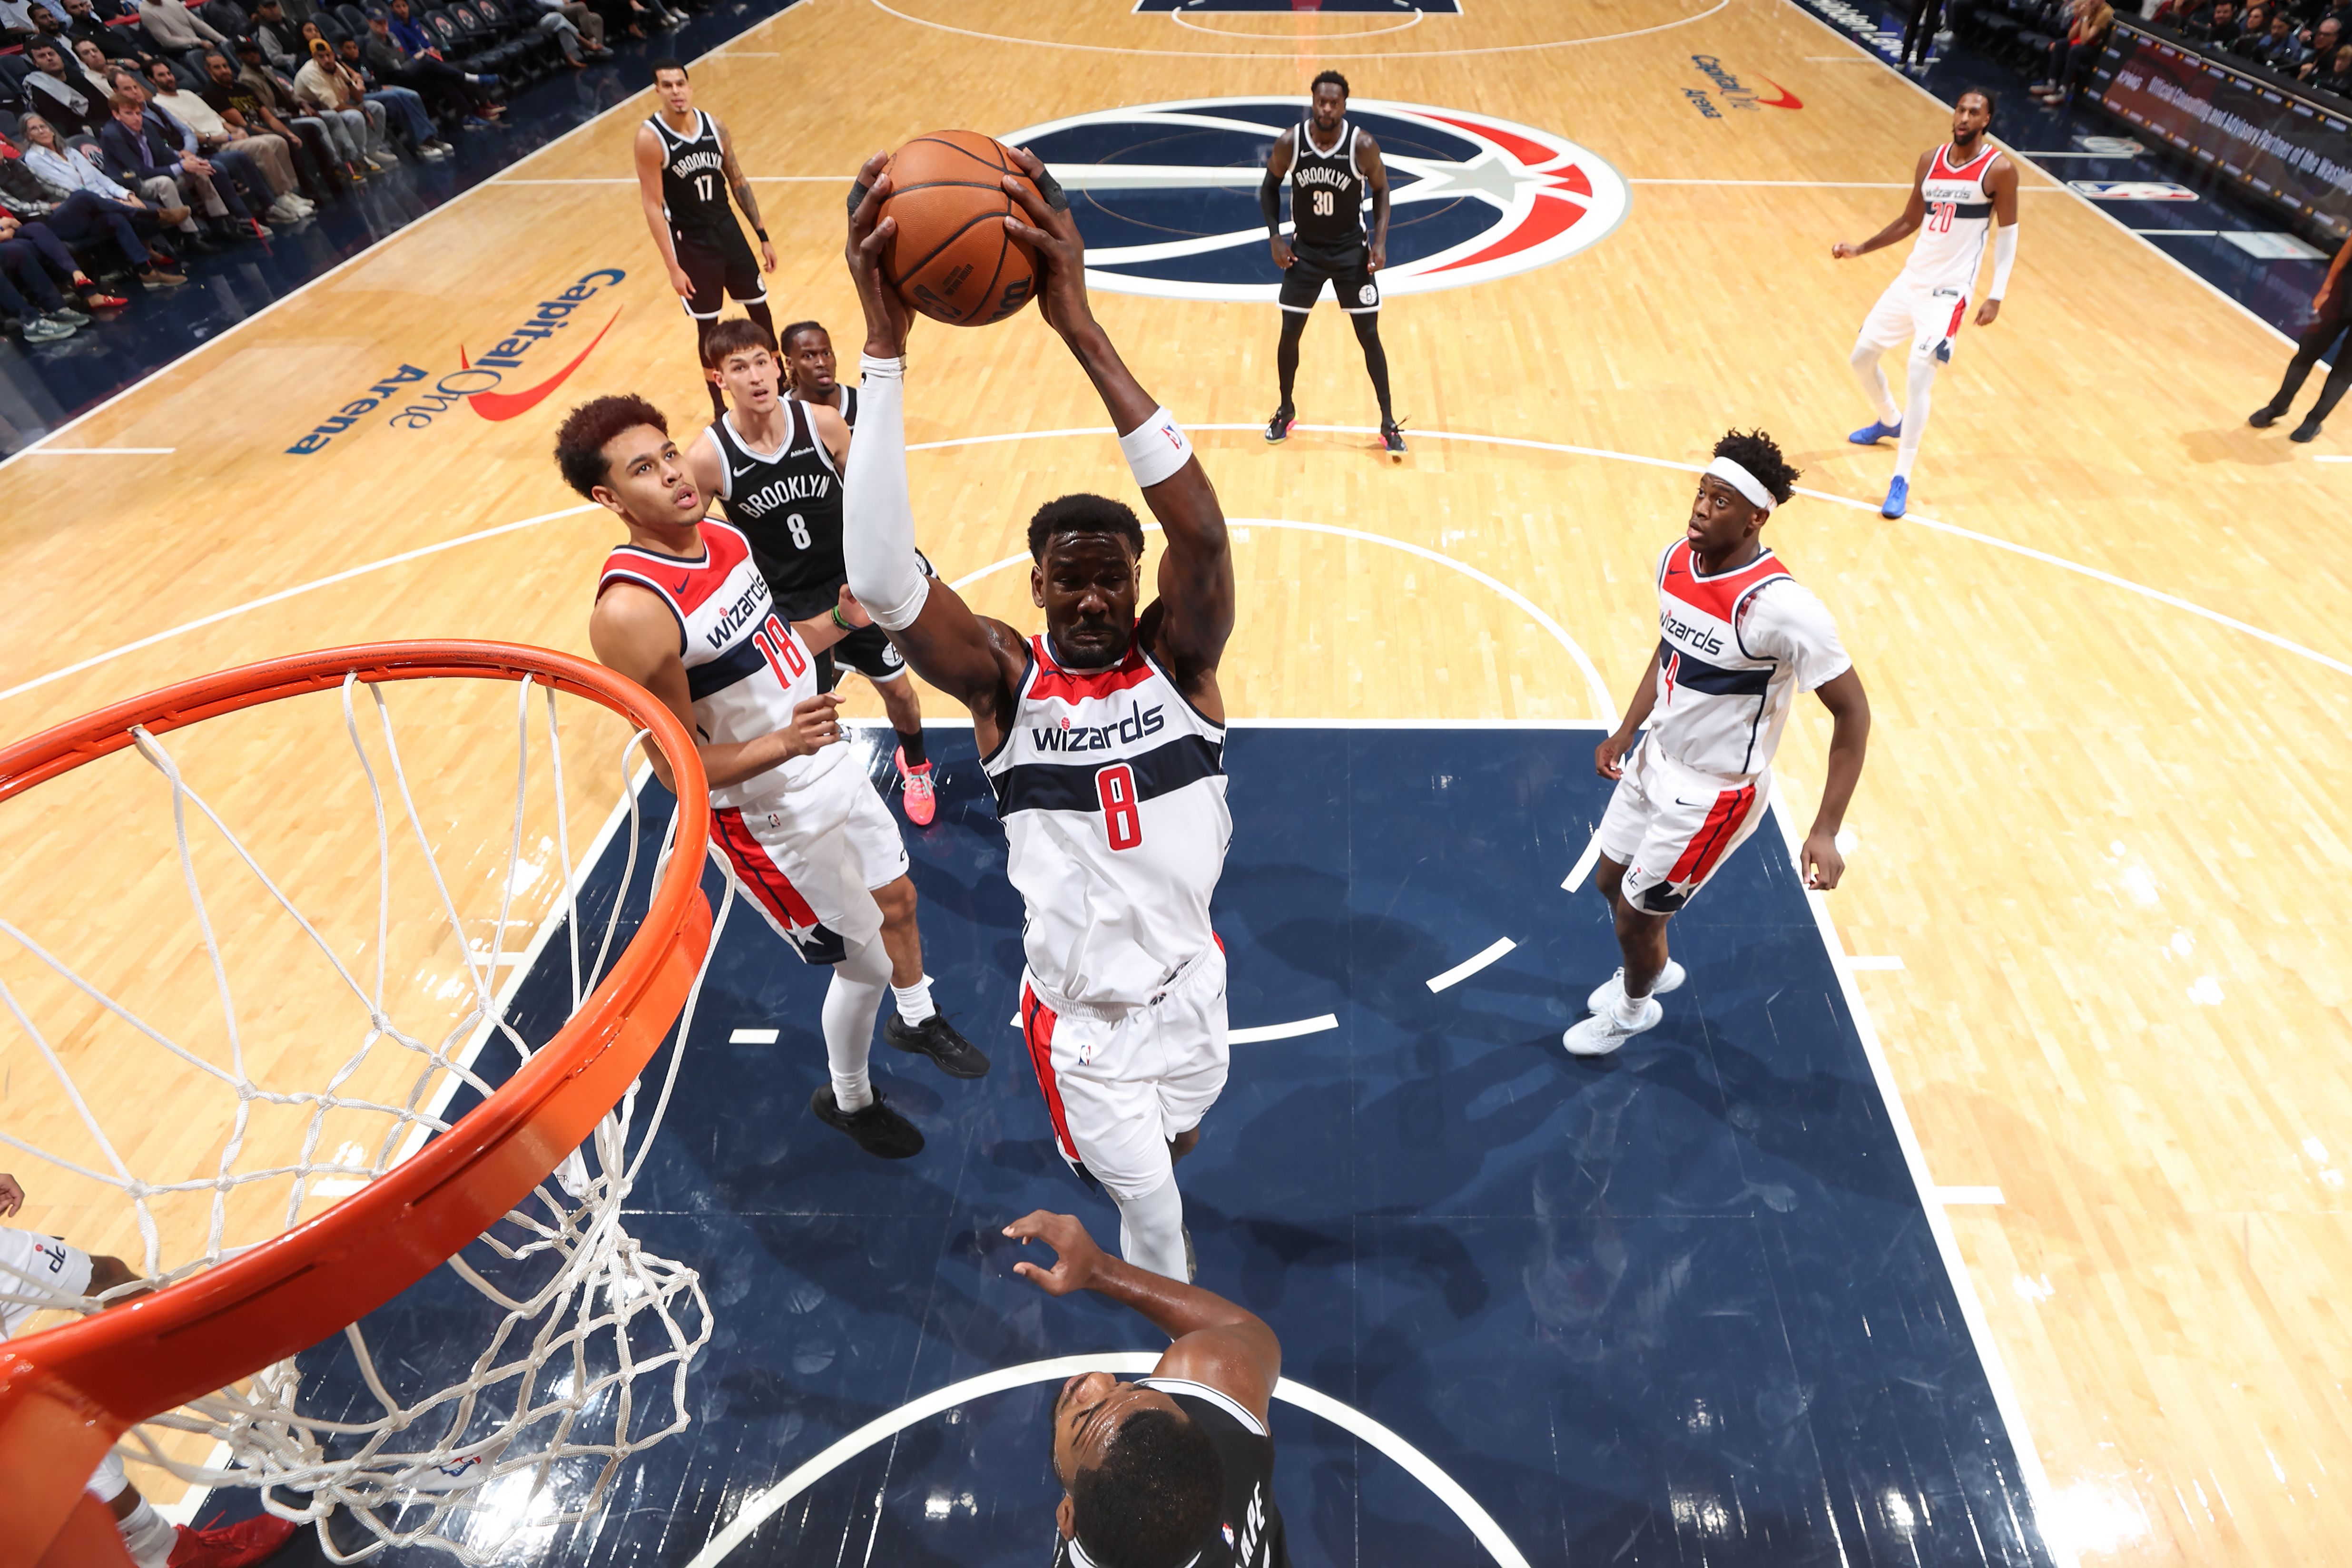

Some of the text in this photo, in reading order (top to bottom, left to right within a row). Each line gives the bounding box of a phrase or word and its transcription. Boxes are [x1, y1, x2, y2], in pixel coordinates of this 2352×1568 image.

[671, 151, 724, 179] BROOKLYN
[1295, 166, 1351, 191] BROOKLYN
[694, 174, 713, 202] 17
[1313, 191, 1334, 216] 30
[1925, 185, 1972, 200] wizards
[1929, 202, 1957, 233] 20
[389, 268, 626, 429] Capital One
[284, 363, 429, 455] Arena
[738, 474, 830, 519] BROOKLYN
[787, 513, 812, 550] 8
[706, 569, 768, 650] wizards
[752, 613, 806, 690] 18
[1665, 650, 1681, 707] 4
[1031, 699, 1165, 752] wizards
[1095, 762, 1143, 853] 8
